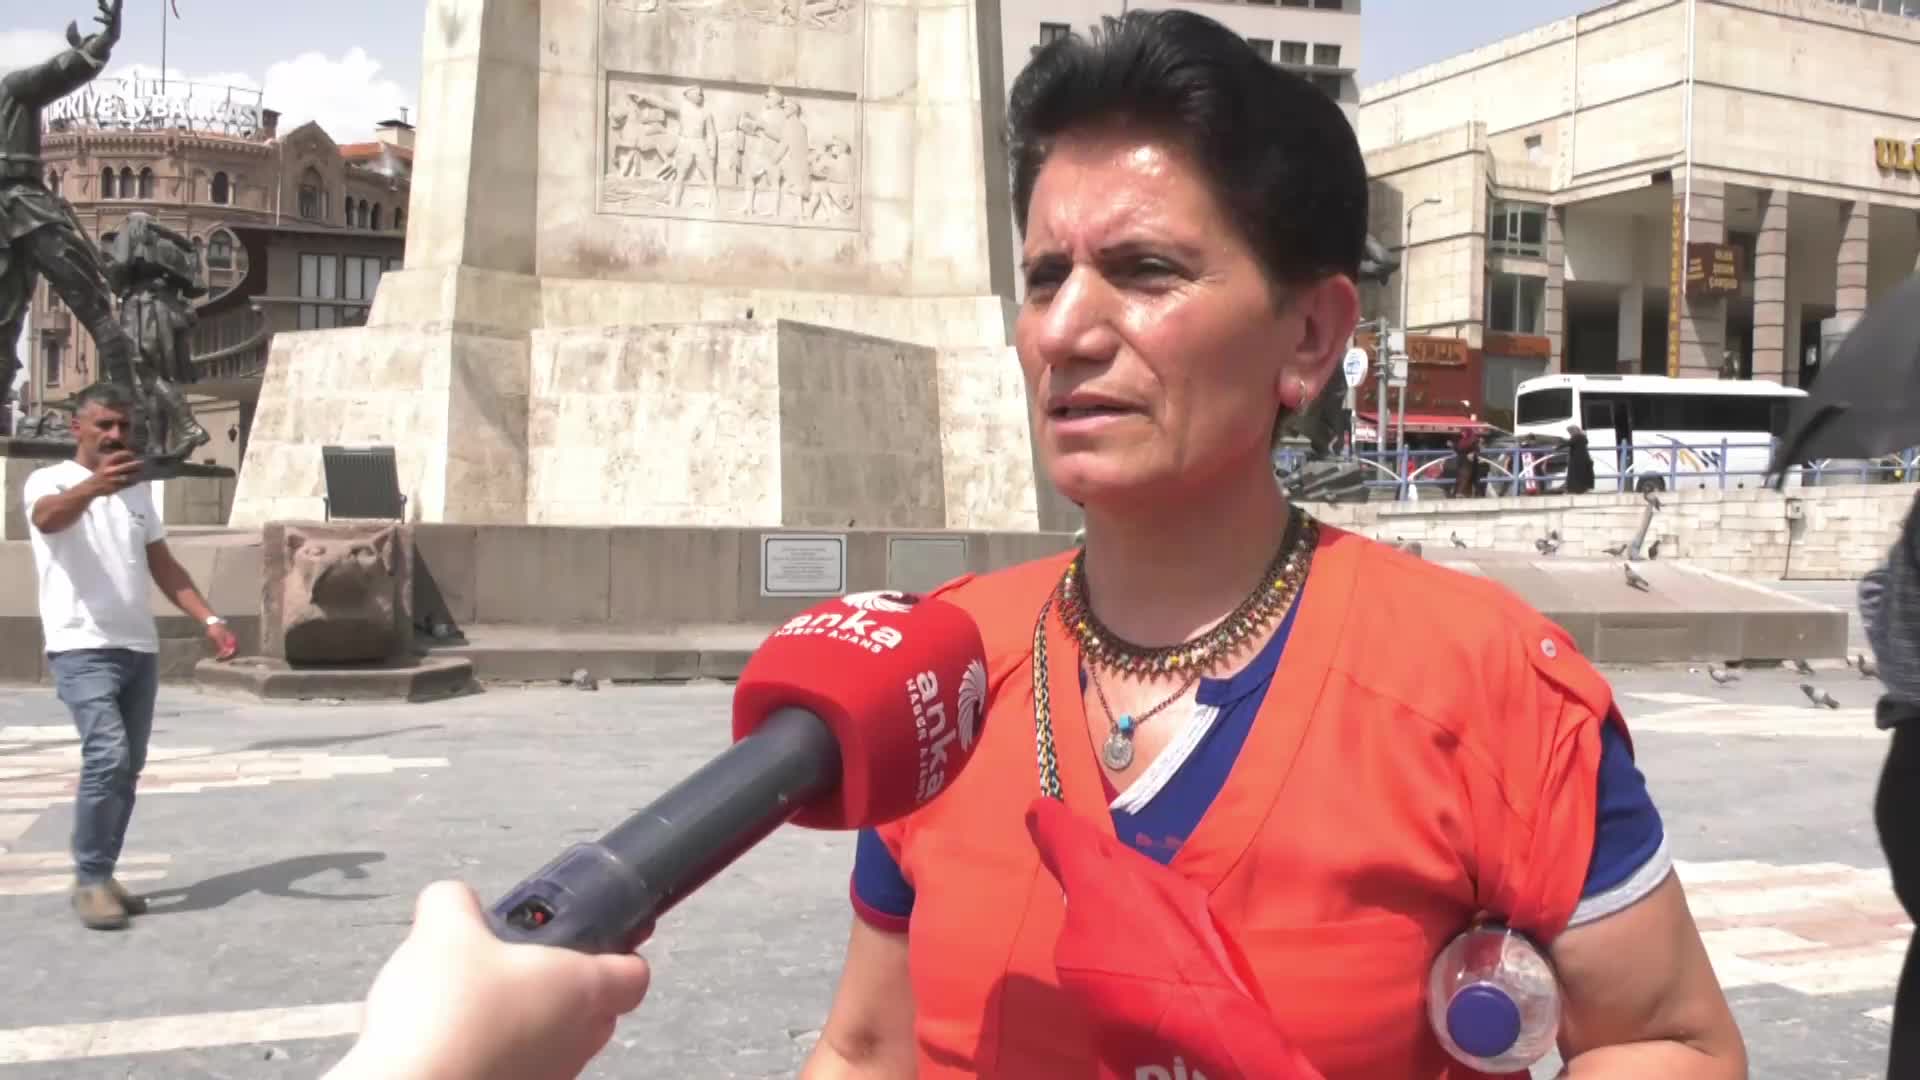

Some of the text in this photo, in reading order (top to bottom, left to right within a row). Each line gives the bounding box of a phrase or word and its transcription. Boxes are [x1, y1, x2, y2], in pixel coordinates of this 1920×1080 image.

[783, 610, 903, 649] anka
[906, 678, 928, 741] HABER
[917, 669, 957, 801] anka
